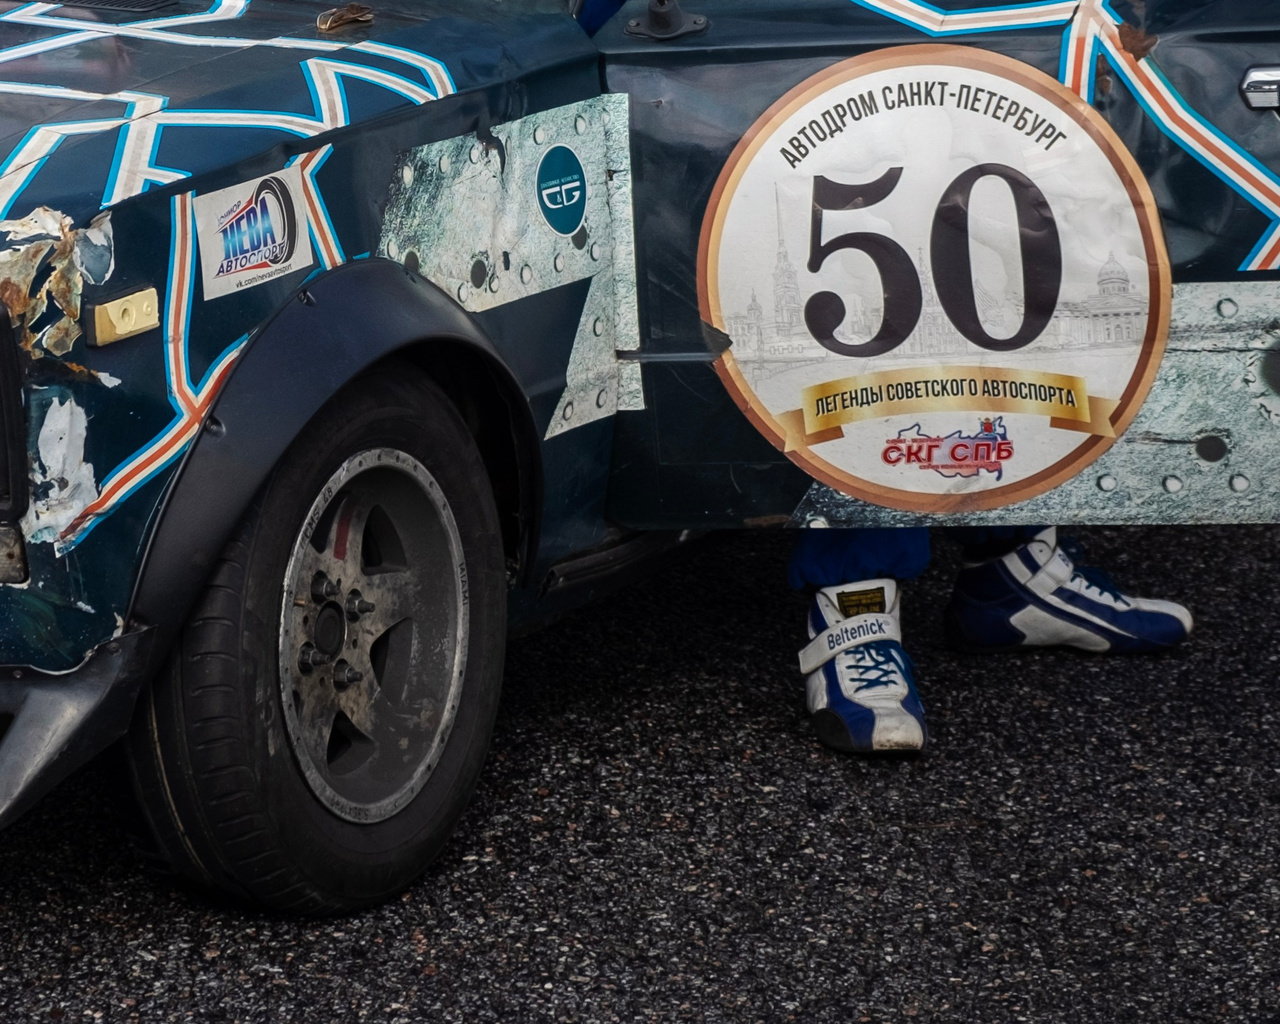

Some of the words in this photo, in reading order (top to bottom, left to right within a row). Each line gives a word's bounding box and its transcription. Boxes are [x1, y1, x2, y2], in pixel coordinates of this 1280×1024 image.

[779, 88, 880, 170] АВТОДРОМ
[881, 81, 1067, 152] САНКТ-ПЕТЕРБУРГ
[220, 196, 277, 262] НЕВА
[215, 242, 286, 277] АВТОСПОРТ
[804, 162, 1062, 358] 50
[814, 385, 886, 417] ЛЕГЕНДЫ
[886, 378, 978, 402] СОВЕТСКОГО
[982, 379, 1078, 408] АВТОСПОРТА
[882, 443, 941, 466] СКГ
[950, 440, 1014, 463] СПБ
[827, 618, 887, 651] Beltenick
